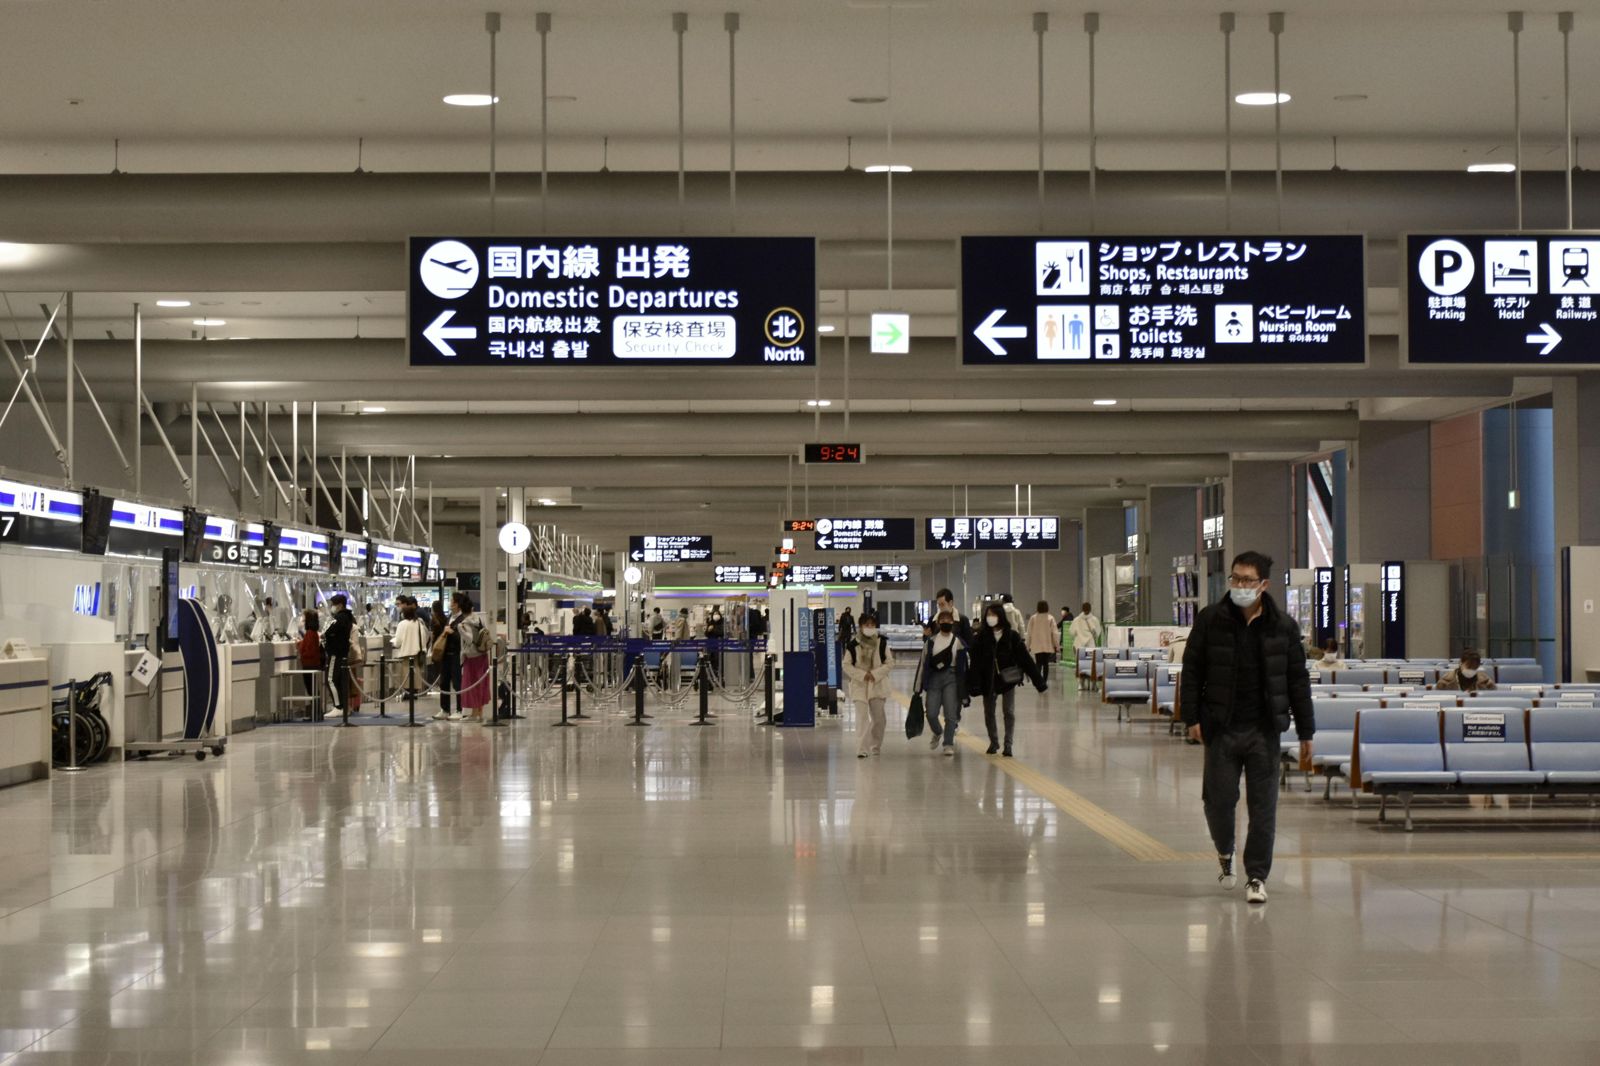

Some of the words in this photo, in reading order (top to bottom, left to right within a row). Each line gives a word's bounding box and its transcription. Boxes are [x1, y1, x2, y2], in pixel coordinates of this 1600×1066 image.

[1099, 241, 1306, 262] ショップ・レストラン
[488, 245, 600, 278] 国内線
[617, 245, 690, 278] 出発
[1100, 264, 1150, 283] Shops,
[1157, 264, 1248, 280] Restaurants
[489, 286, 598, 308] Domestic
[609, 286, 738, 313] Departures
[1494, 297, 1530, 308] ホテル
[1129, 305, 1197, 326] お手洗
[1259, 305, 1351, 319] ベビールーム
[1430, 309, 1465, 321] Parking
[1499, 310, 1524, 319] Hotel
[1556, 309, 1597, 321] Railways
[489, 316, 600, 333] 国内航线出发
[623, 320, 726, 339] 保安検査場
[771, 314, 798, 340] 北
[1259, 321, 1303, 335] Nursing
[1306, 321, 1336, 332] Room
[1130, 328, 1182, 343] Toilets
[489, 341, 544, 358] 국내선
[552, 340, 589, 358] 출발
[624, 341, 680, 355] Security
[685, 341, 724, 353] Check
[765, 347, 804, 361] North
[820, 446, 857, 461] 9:24
[2, 516, 15, 537] 7
[792, 521, 813, 530] 9:24
[834, 530, 861, 539] Domestic
[227, 545, 239, 560] 6
[263, 549, 273, 564] 5
[301, 553, 311, 567] 4
[380, 563, 389, 576] 3
[403, 566, 410, 578] 2
[827, 629, 836, 667] ENTRANCE
